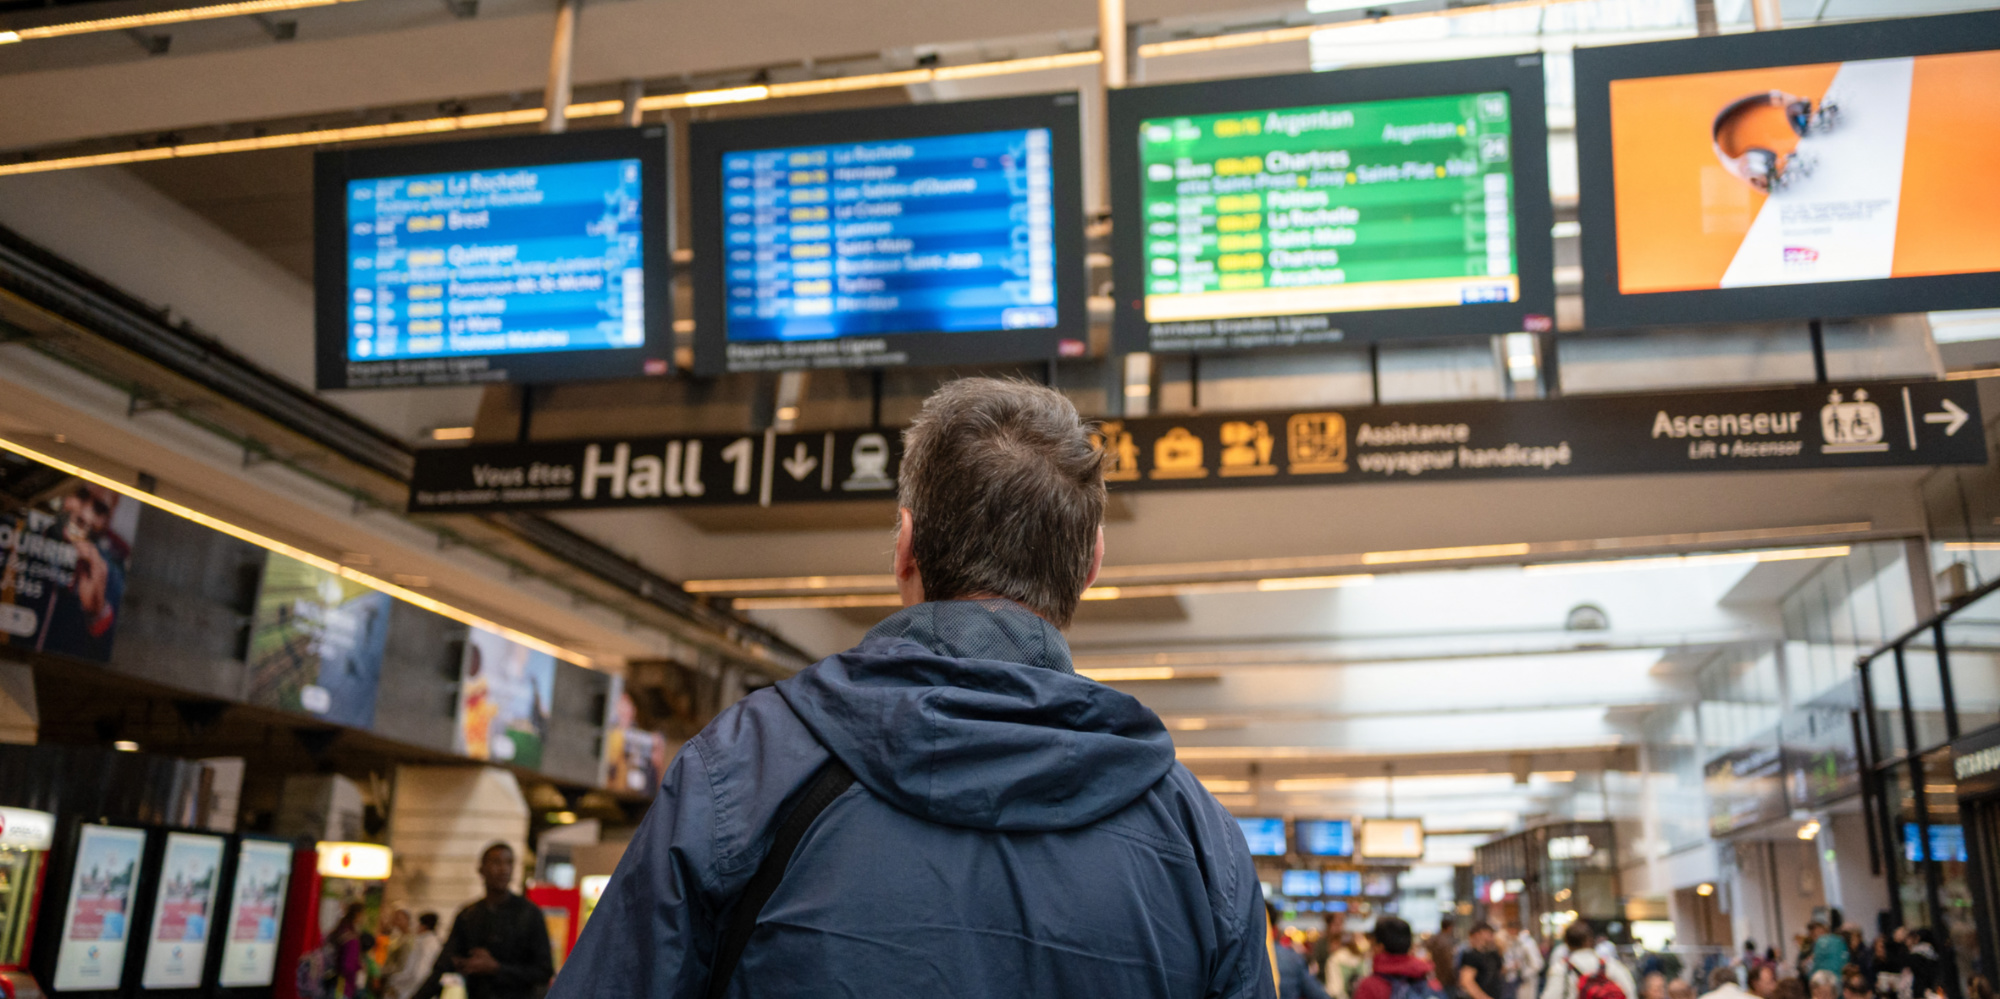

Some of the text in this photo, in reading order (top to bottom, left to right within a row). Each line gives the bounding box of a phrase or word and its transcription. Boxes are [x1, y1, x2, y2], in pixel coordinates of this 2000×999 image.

[1264, 110, 1354, 137] Argentan
[1382, 122, 1456, 145] Argentan
[1265, 150, 1350, 174] Chartres
[470, 171, 538, 193] Rochelle
[449, 210, 489, 230] Brest
[448, 244, 518, 267] Quimper
[1356, 422, 1470, 447] Assistance
[1652, 410, 1802, 439] Ascenseur
[1356, 441, 1572, 476] voyageur handicapé
[1688, 438, 1803, 459] Lift Ascensor
[473, 461, 574, 487] Vous êtes
[580, 437, 754, 499] Hall 1
